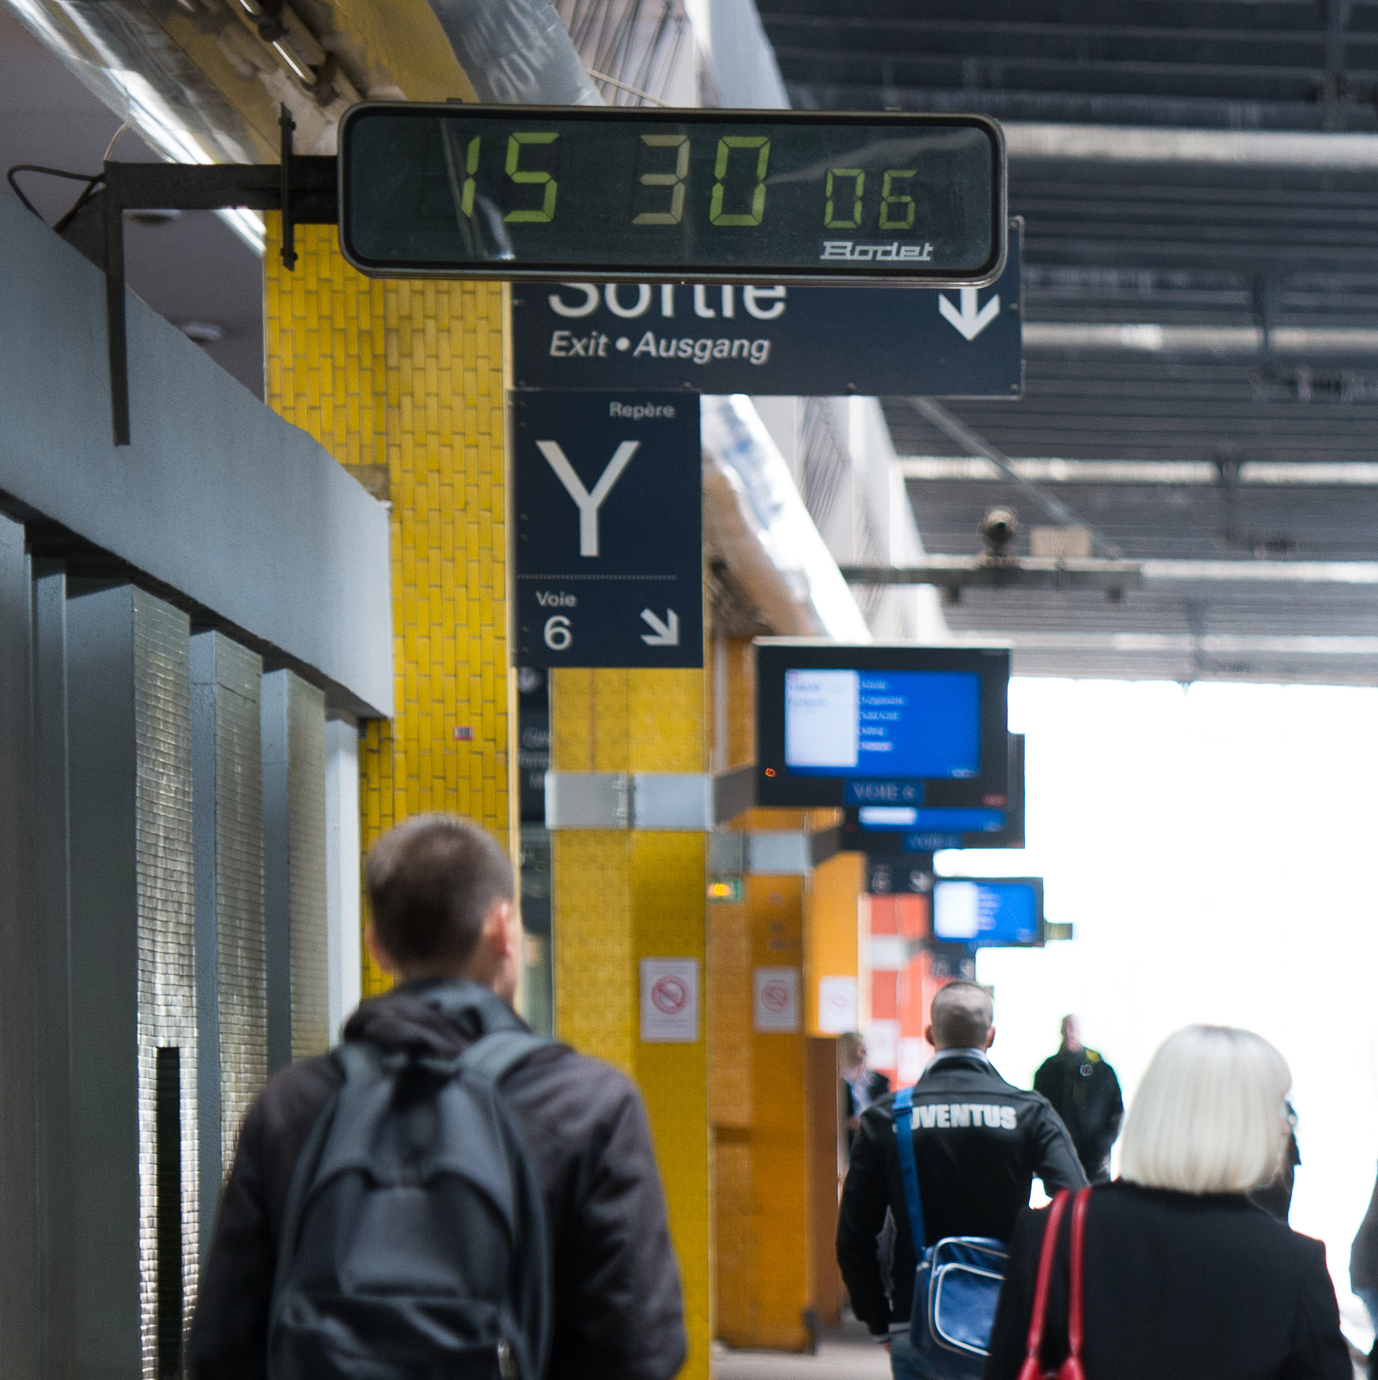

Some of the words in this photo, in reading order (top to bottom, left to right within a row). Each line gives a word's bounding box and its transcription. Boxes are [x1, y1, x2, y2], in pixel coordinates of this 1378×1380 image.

[460, 131, 560, 224] 15
[631, 134, 772, 227] 30
[824, 168, 918, 230] 06
[820, 241, 934, 261] Bodet
[549, 329, 611, 358] Exit
[632, 330, 771, 366] Ausgang
[609, 401, 676, 420] Repère
[534, 440, 641, 558] Y
[535, 590, 578, 608] Voie
[543, 614, 573, 651] 6
[891, 1103, 1018, 1133] UVENTUS
